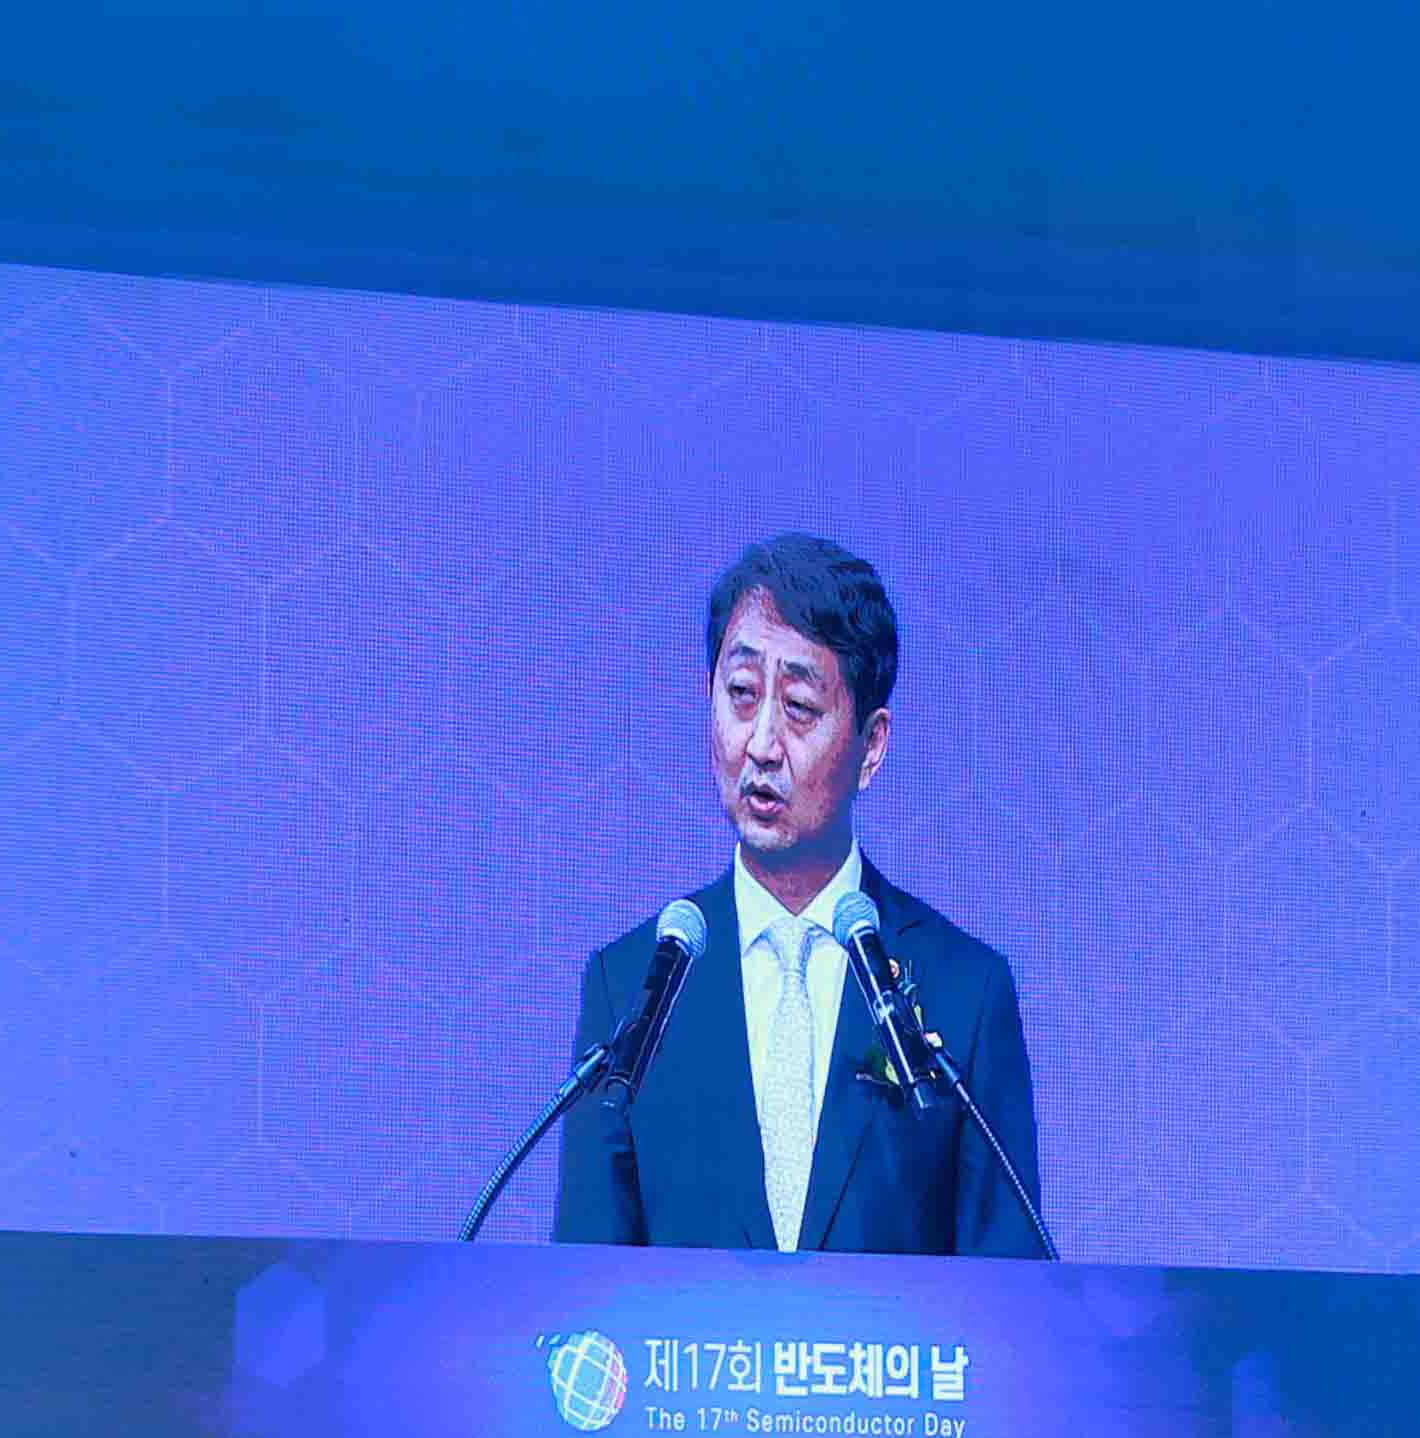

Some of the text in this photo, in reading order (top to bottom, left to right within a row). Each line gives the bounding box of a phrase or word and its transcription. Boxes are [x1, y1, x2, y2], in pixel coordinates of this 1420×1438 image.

[643, 1338, 969, 1401] 제17회 반도체의 날
[644, 1405, 686, 1431] The
[697, 1406, 741, 1432] 17th
[746, 1406, 916, 1436] Semiconductor
